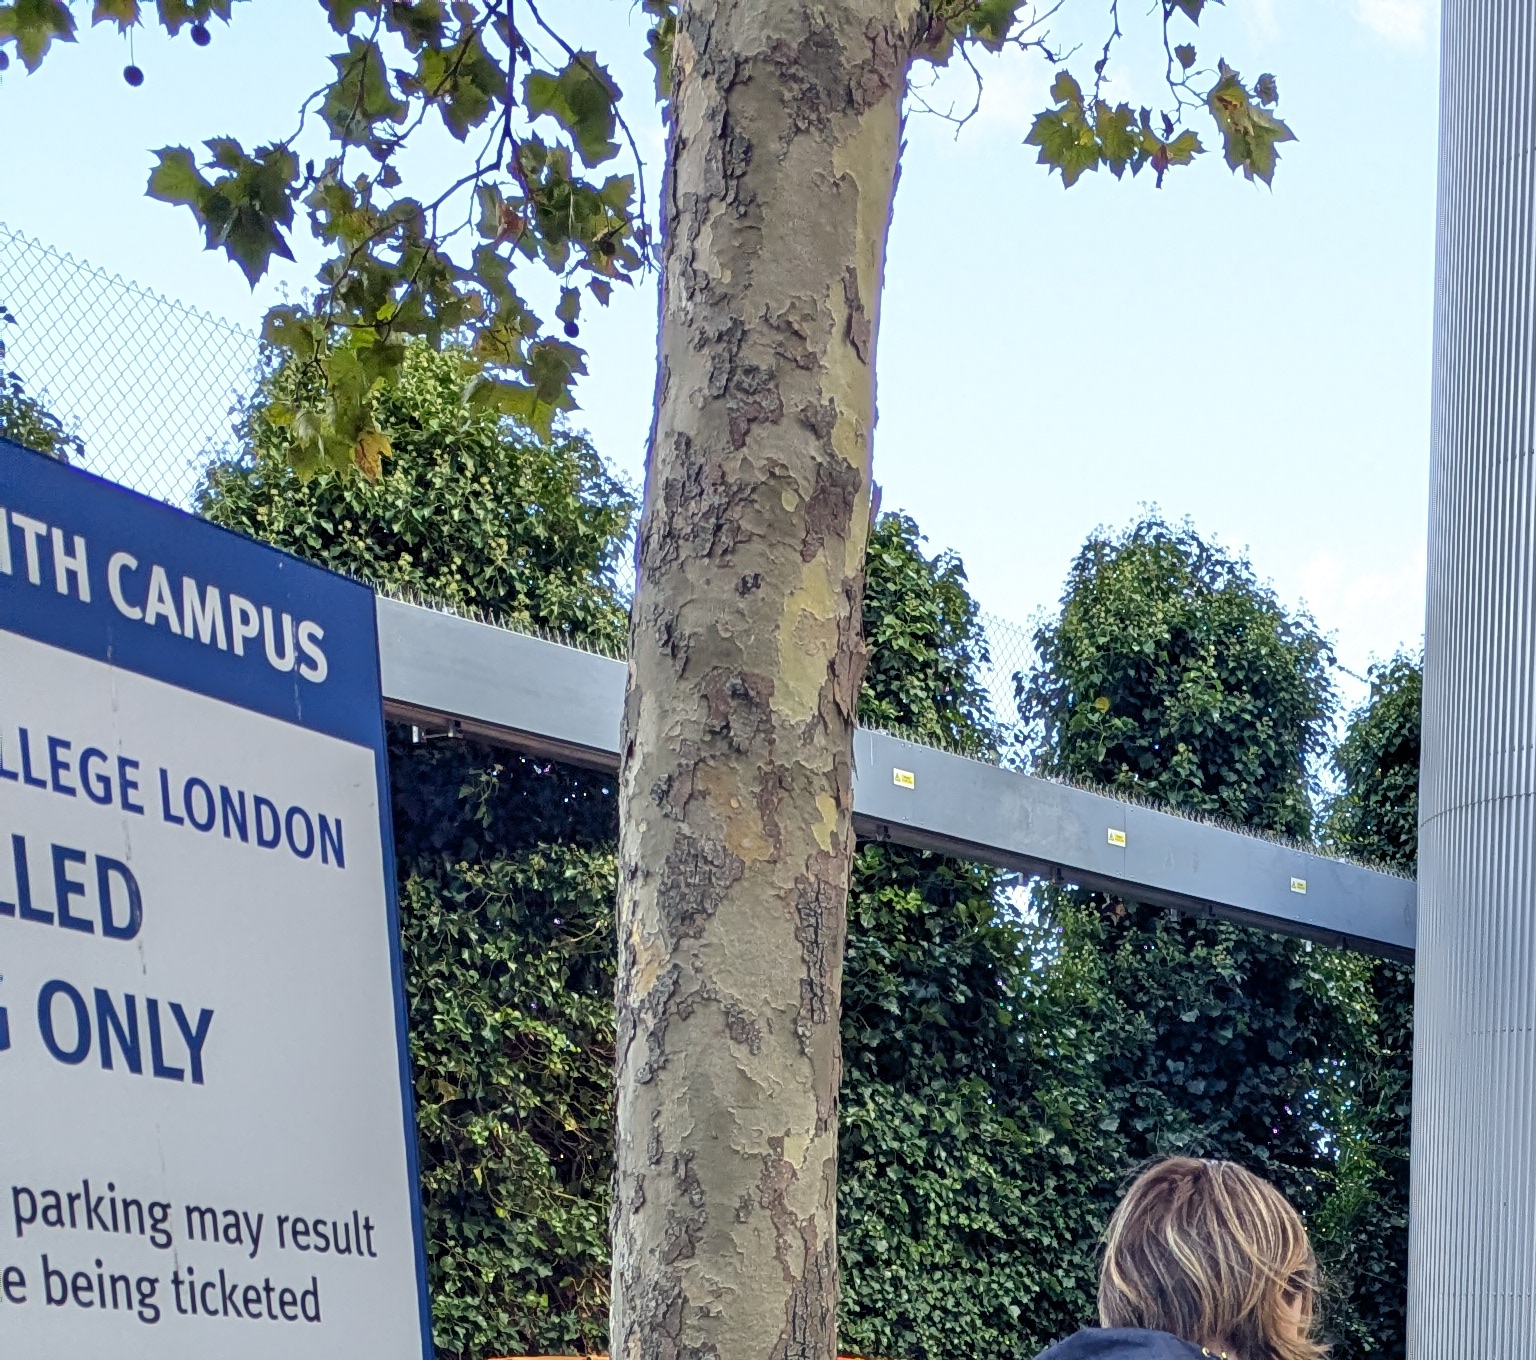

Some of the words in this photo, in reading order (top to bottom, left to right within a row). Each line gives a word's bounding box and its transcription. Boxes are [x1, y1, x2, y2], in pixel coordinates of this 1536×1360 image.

[107, 551, 329, 684] CAMPUS
[159, 767, 345, 870] LONDON
[37, 979, 214, 1086] ONLY
[11, 1179, 173, 1250] parking
[185, 1204, 264, 1259] may
[277, 1209, 378, 1258] result
[1, 1265, 27, 1304] e
[41, 1253, 161, 1325] being
[171, 1266, 322, 1323] ticketed
